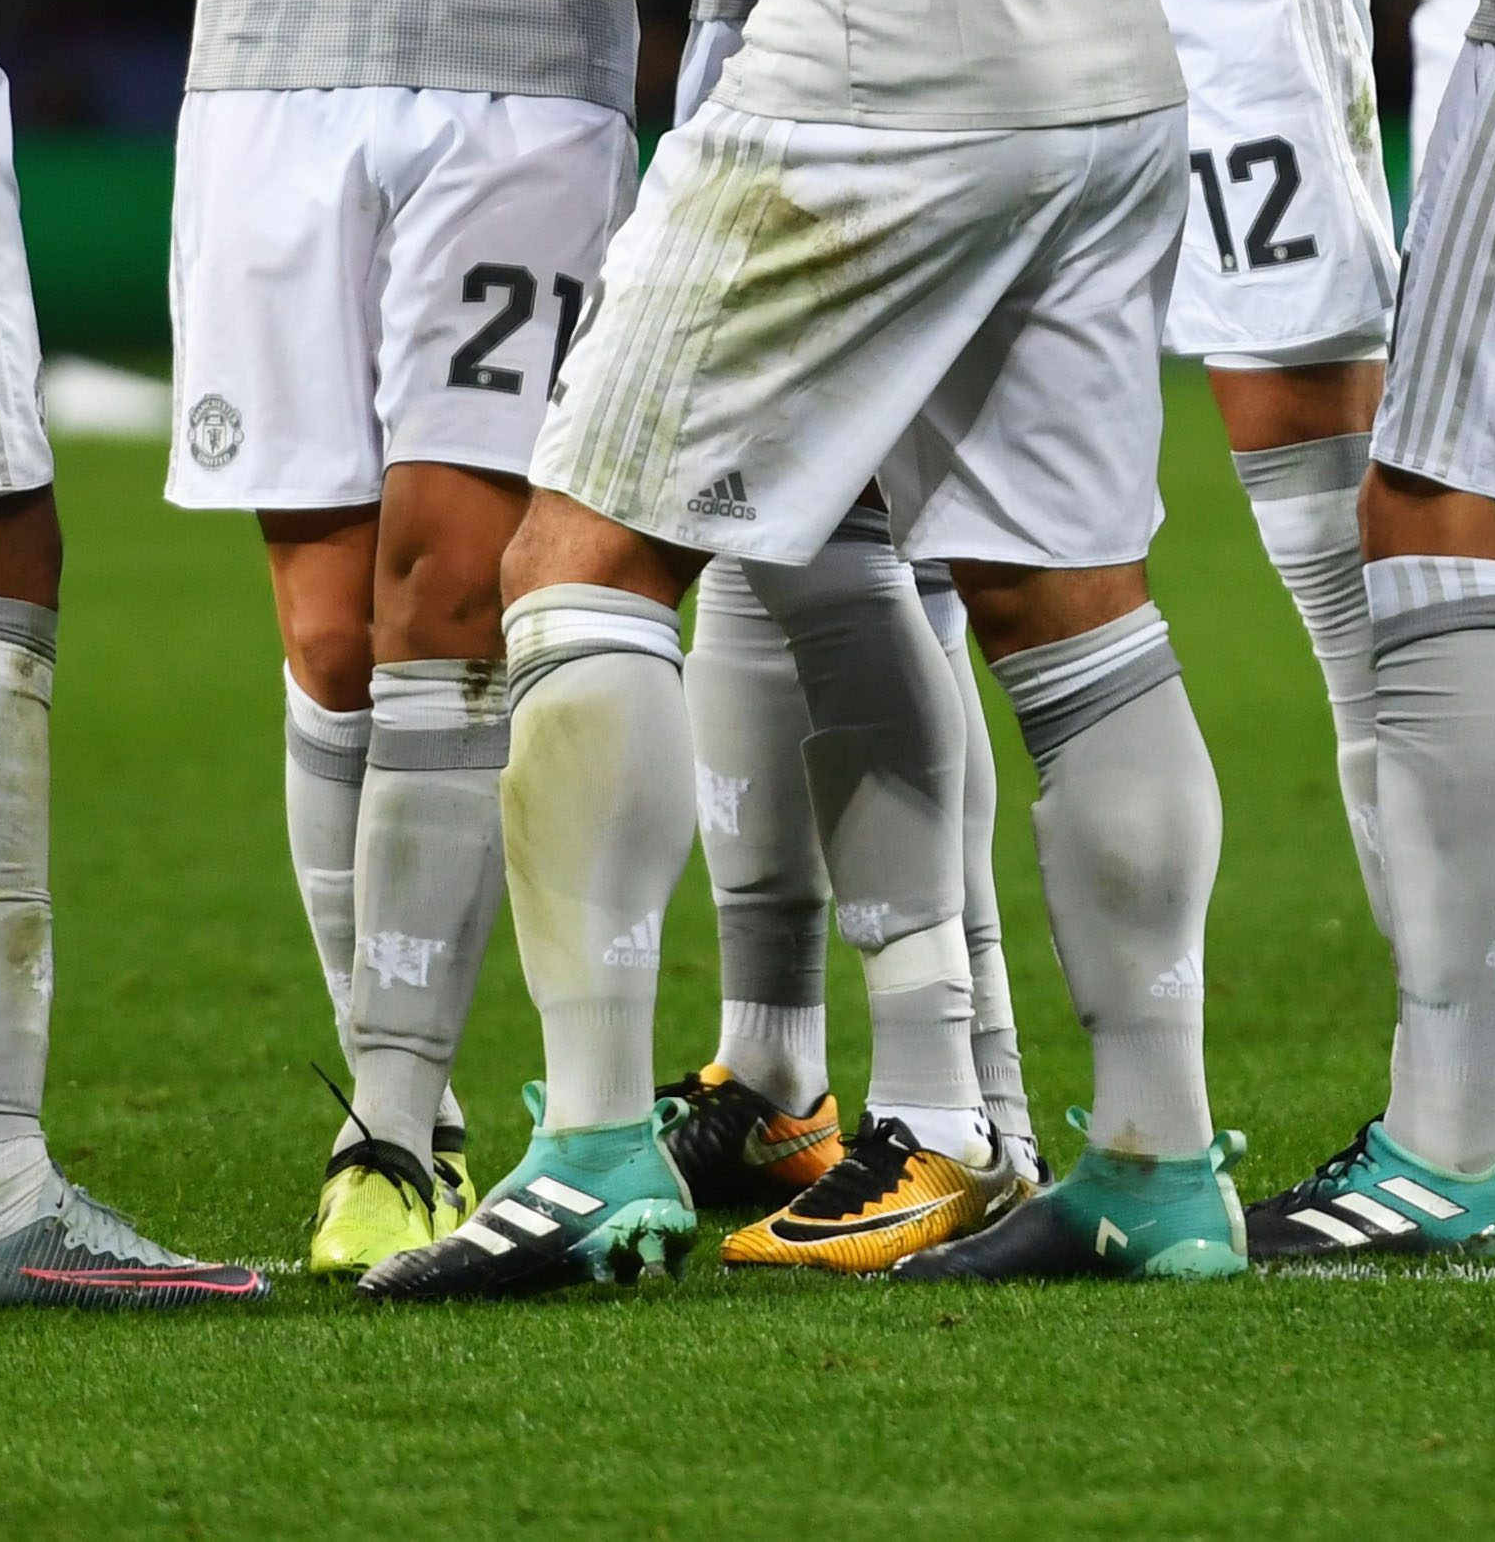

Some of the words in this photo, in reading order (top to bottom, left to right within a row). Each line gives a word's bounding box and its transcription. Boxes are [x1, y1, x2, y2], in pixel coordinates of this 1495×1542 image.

[1189, 134, 1320, 274] 12
[446, 261, 585, 403] 21
[687, 497, 757, 521] adidas
